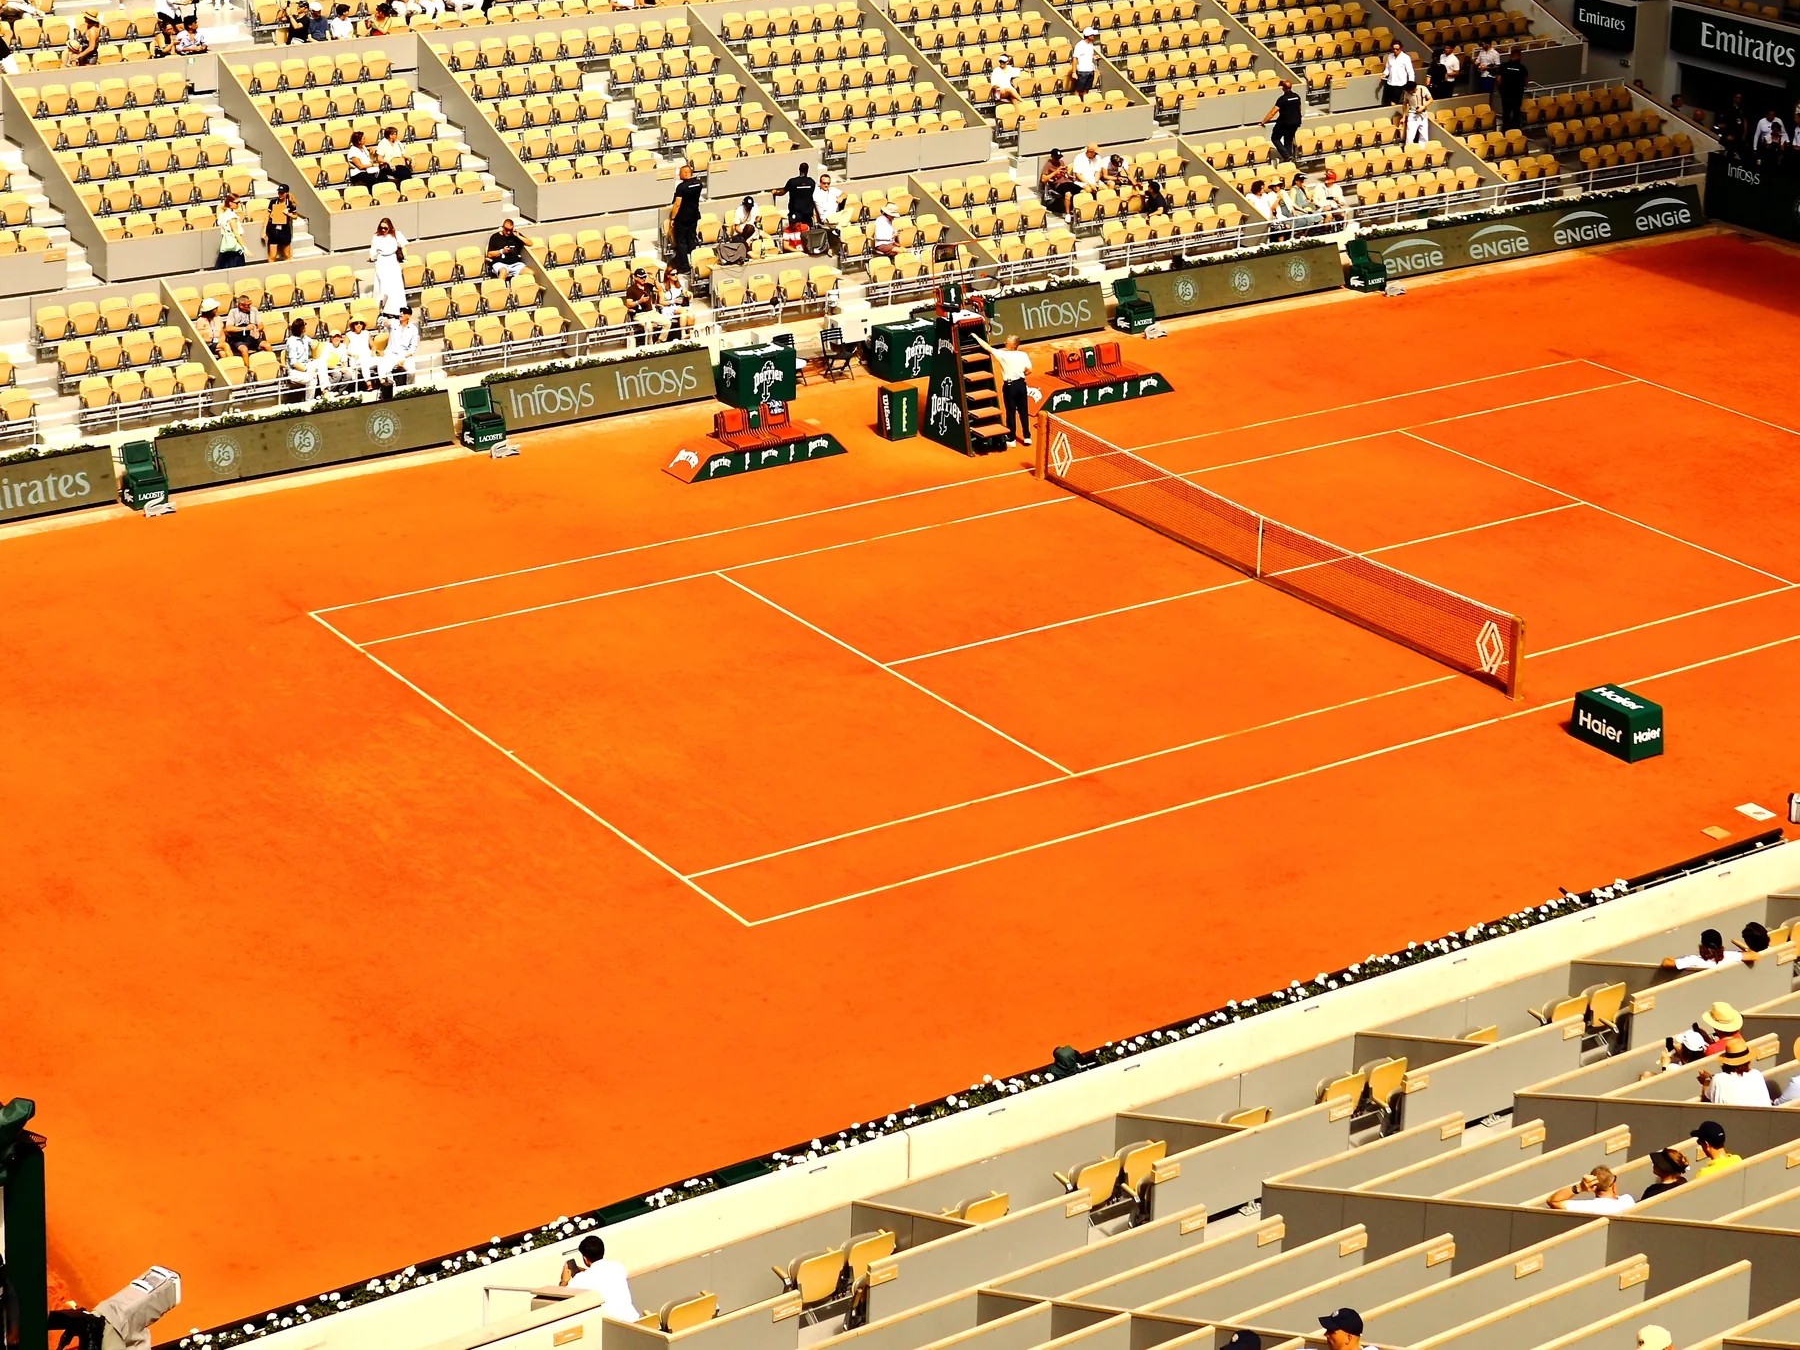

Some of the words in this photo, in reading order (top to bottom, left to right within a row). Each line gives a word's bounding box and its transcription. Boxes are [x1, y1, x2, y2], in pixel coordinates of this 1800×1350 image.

[1579, 8, 1626, 31] Emirates
[1700, 21, 1796, 68] Emirates
[1727, 162, 1761, 186] Infosys
[1020, 299, 1092, 331] Infosys
[615, 365, 697, 401] Infosys
[510, 382, 594, 418] Infosys
[479, 433, 503, 443] LACOSTE
[0, 472, 91, 511] irates
[138, 490, 165, 501] LACOSTE
[1592, 687, 1645, 710] Haier
[1579, 709, 1623, 744] Haier
[1633, 726, 1662, 745] Haier
